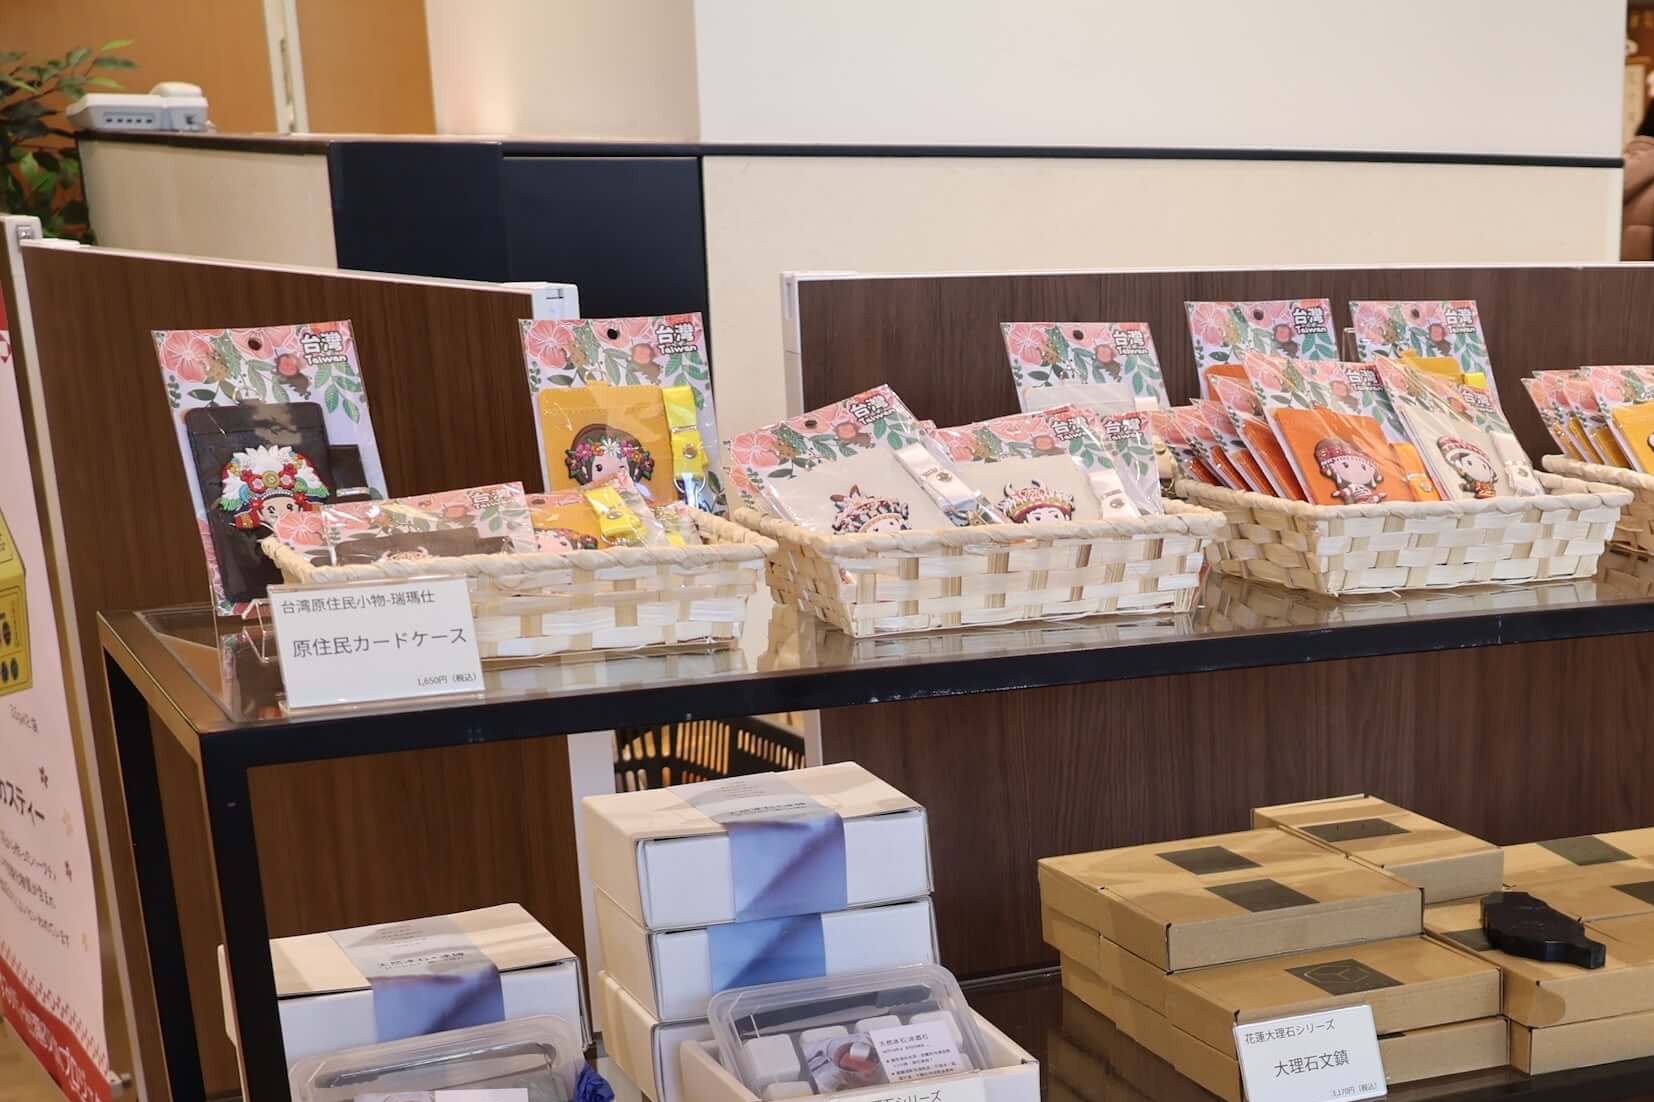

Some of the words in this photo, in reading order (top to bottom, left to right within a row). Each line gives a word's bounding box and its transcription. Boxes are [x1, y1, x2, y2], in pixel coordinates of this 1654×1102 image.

[1292, 307, 1326, 325] 台灣
[1444, 308, 1474, 326] 台灣
[656, 322, 695, 345] 台灣
[1112, 329, 1145, 347] 台灣
[1295, 324, 1329, 334] Taiwan
[300, 331, 344, 354] 台灣
[658, 343, 698, 355] Taiwan
[304, 353, 348, 365] Taiwan
[849, 394, 890, 419] 台灣
[858, 408, 897, 426] Taiwan
[292, 627, 468, 659] 原住民カードケース
[1245, 1018, 1336, 1046] 花蓮大理石シリーズ
[1274, 1049, 1350, 1079] 大理石文鎮
